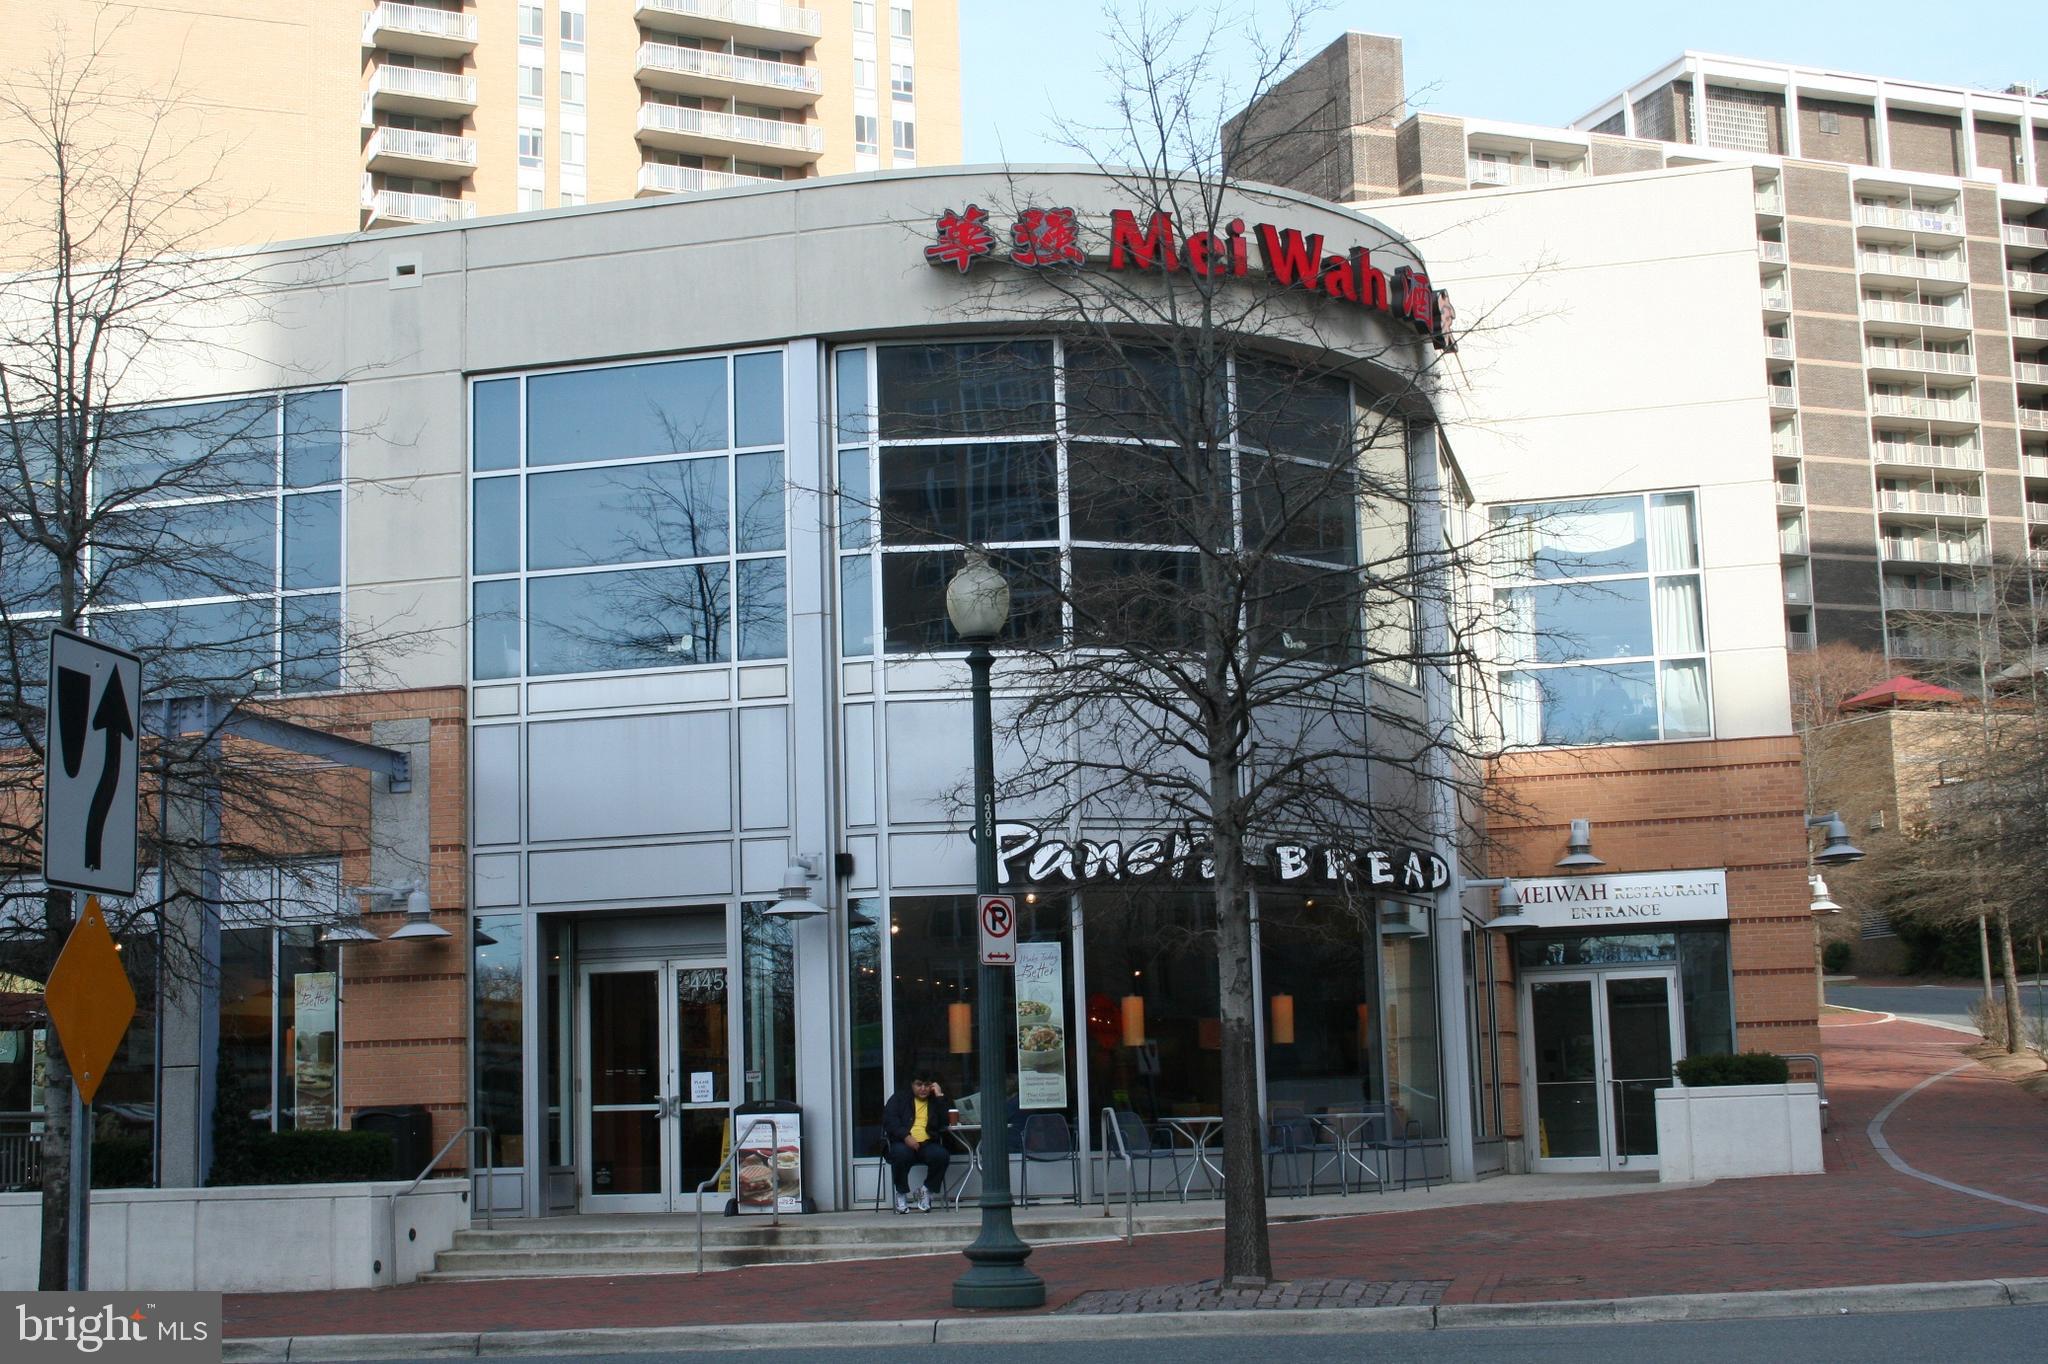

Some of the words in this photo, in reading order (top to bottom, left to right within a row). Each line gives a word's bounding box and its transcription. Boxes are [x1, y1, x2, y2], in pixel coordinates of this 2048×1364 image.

[1110, 209, 1249, 279] Mei
[1252, 222, 1389, 312] Wah
[984, 793, 992, 838] 04020
[970, 821, 1218, 886] Paner
[1275, 845, 1449, 890] BREAD
[1514, 883, 1608, 905] MEIWAH
[1614, 881, 1721, 900] RESTAURANT
[1570, 903, 1662, 920] ENTRANCE
[689, 971, 729, 991] 445
[1022, 961, 1056, 979] Better
